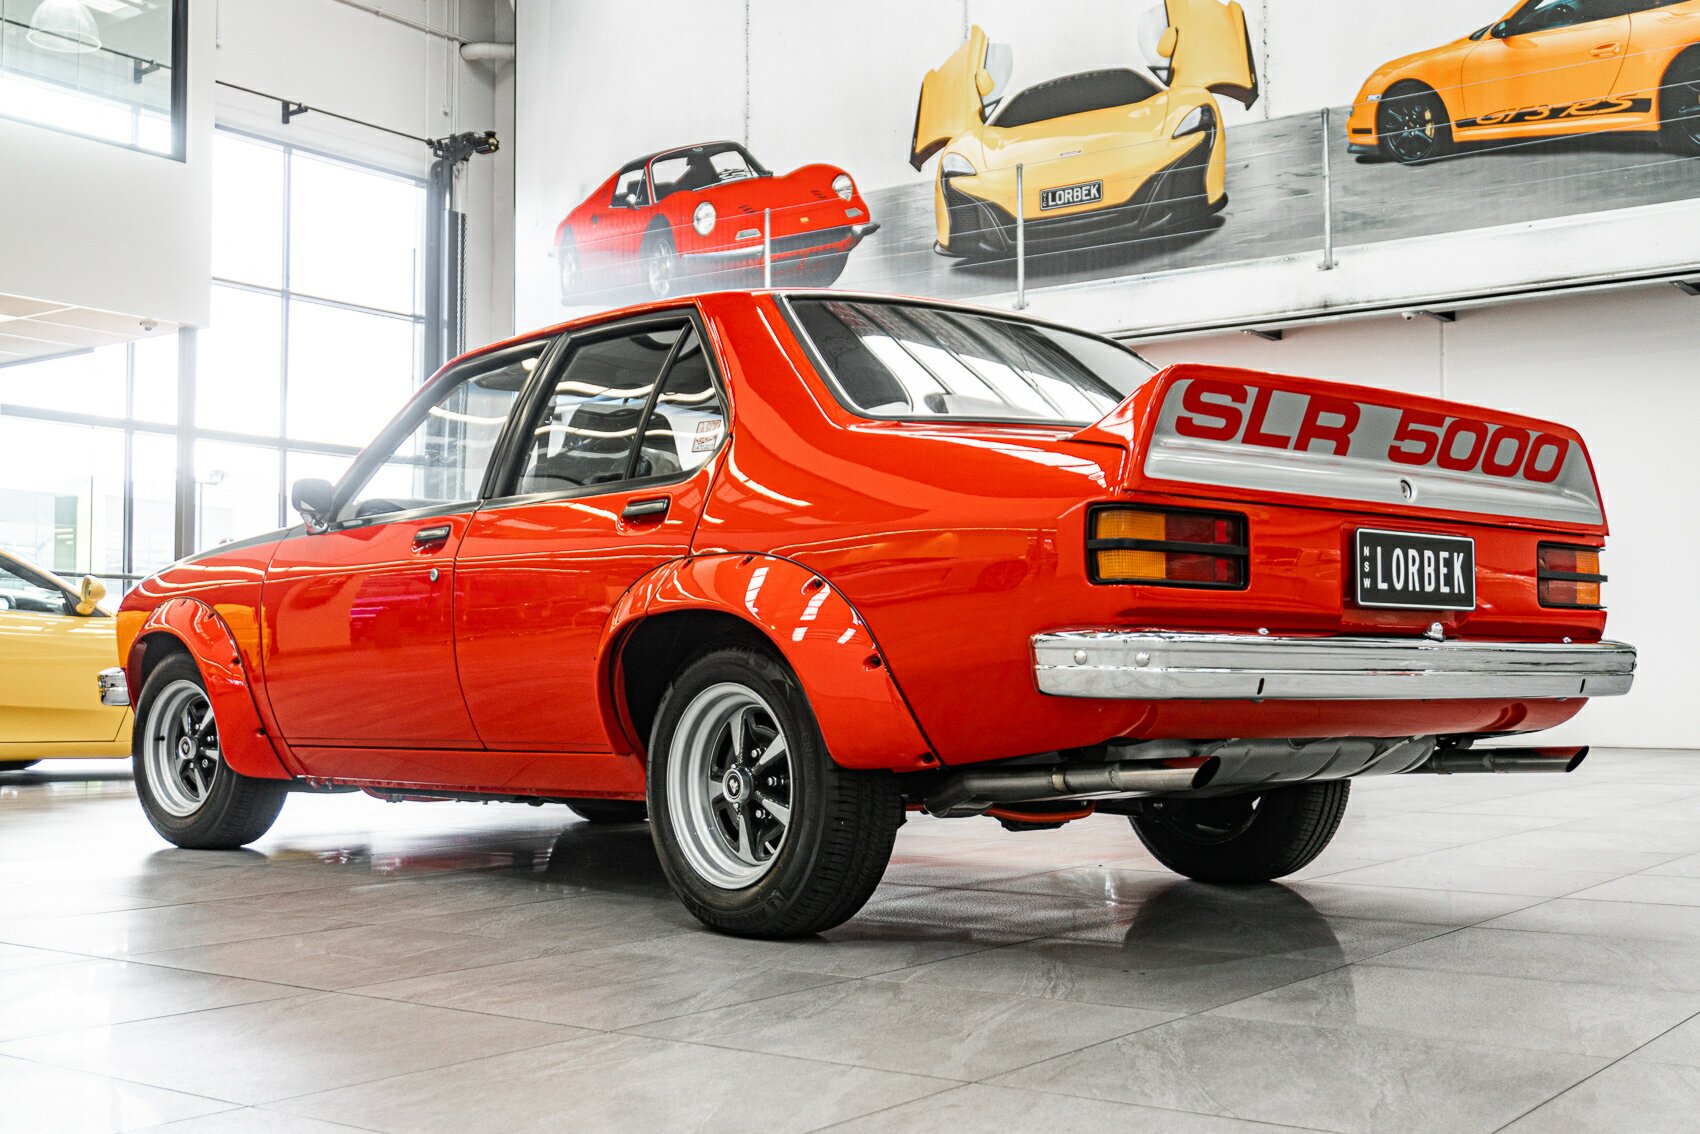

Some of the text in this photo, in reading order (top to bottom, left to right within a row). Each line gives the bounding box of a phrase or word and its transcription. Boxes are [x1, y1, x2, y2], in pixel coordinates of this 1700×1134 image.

[1048, 184, 1100, 206] LORBEK
[1175, 379, 1570, 483] SLR 5000
[1377, 546, 1466, 594] LORBEK
